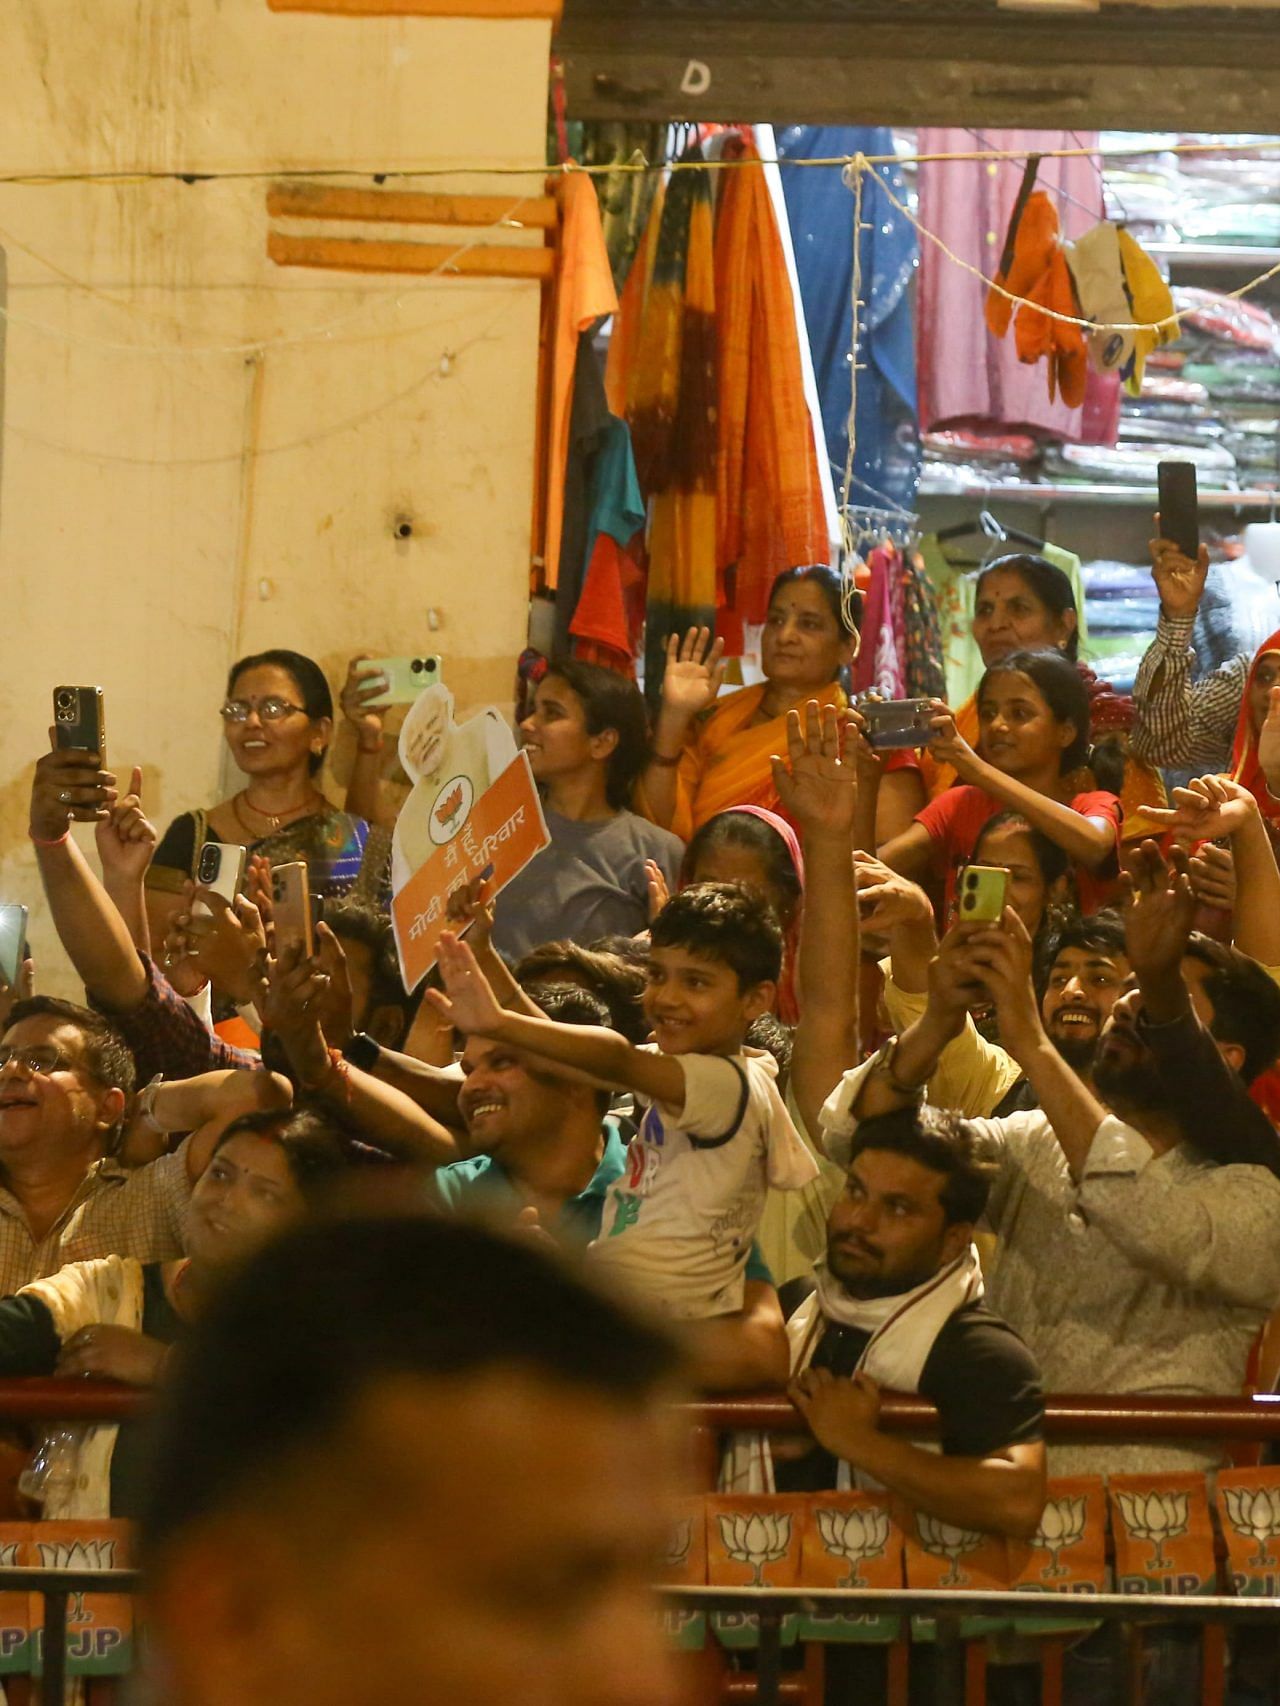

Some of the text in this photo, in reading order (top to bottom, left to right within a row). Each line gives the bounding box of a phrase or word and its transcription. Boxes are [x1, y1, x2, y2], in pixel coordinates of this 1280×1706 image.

[681, 59, 711, 95] D
[408, 895, 442, 941] मोदी
[471, 805, 526, 867] परिवार
[37, 1625, 122, 1660] JP
